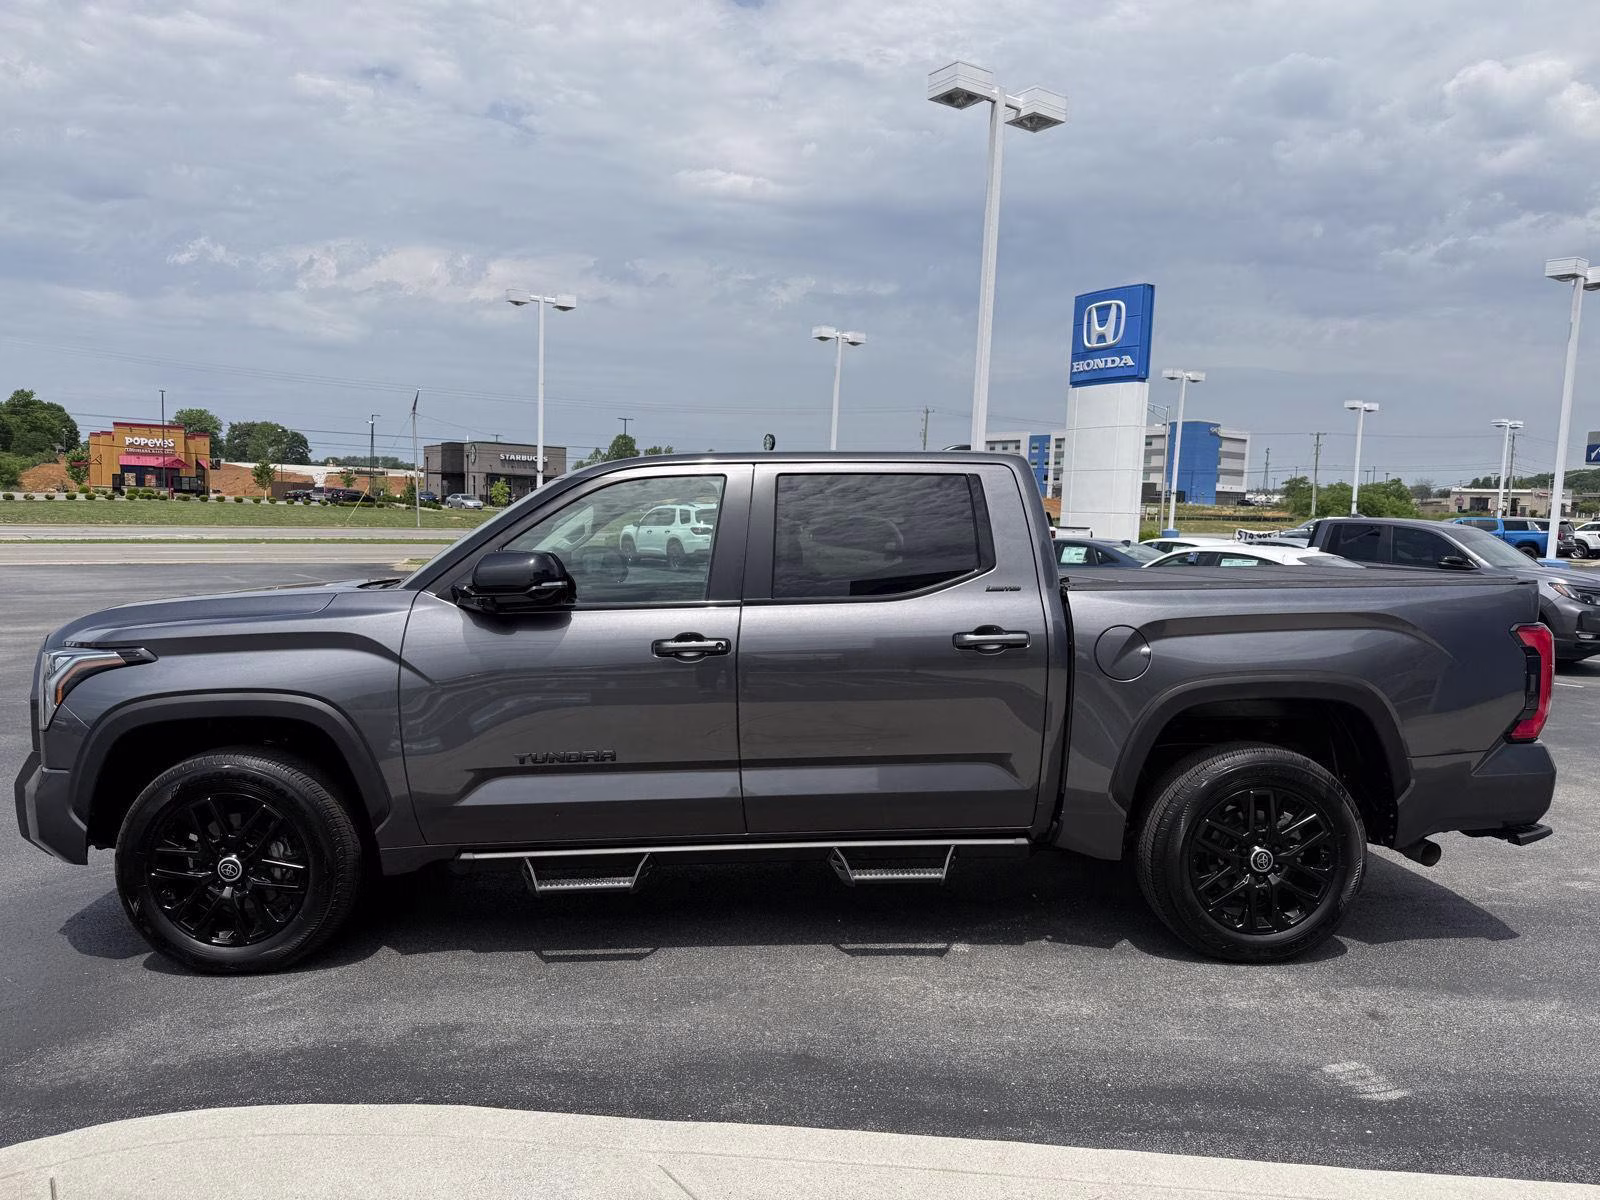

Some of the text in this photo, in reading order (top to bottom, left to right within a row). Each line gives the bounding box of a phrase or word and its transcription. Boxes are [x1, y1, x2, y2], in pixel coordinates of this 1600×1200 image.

[1072, 355, 1135, 372] HONDA
[500, 453, 548, 462] STARBUCS
[513, 750, 616, 764] TUNDRA
